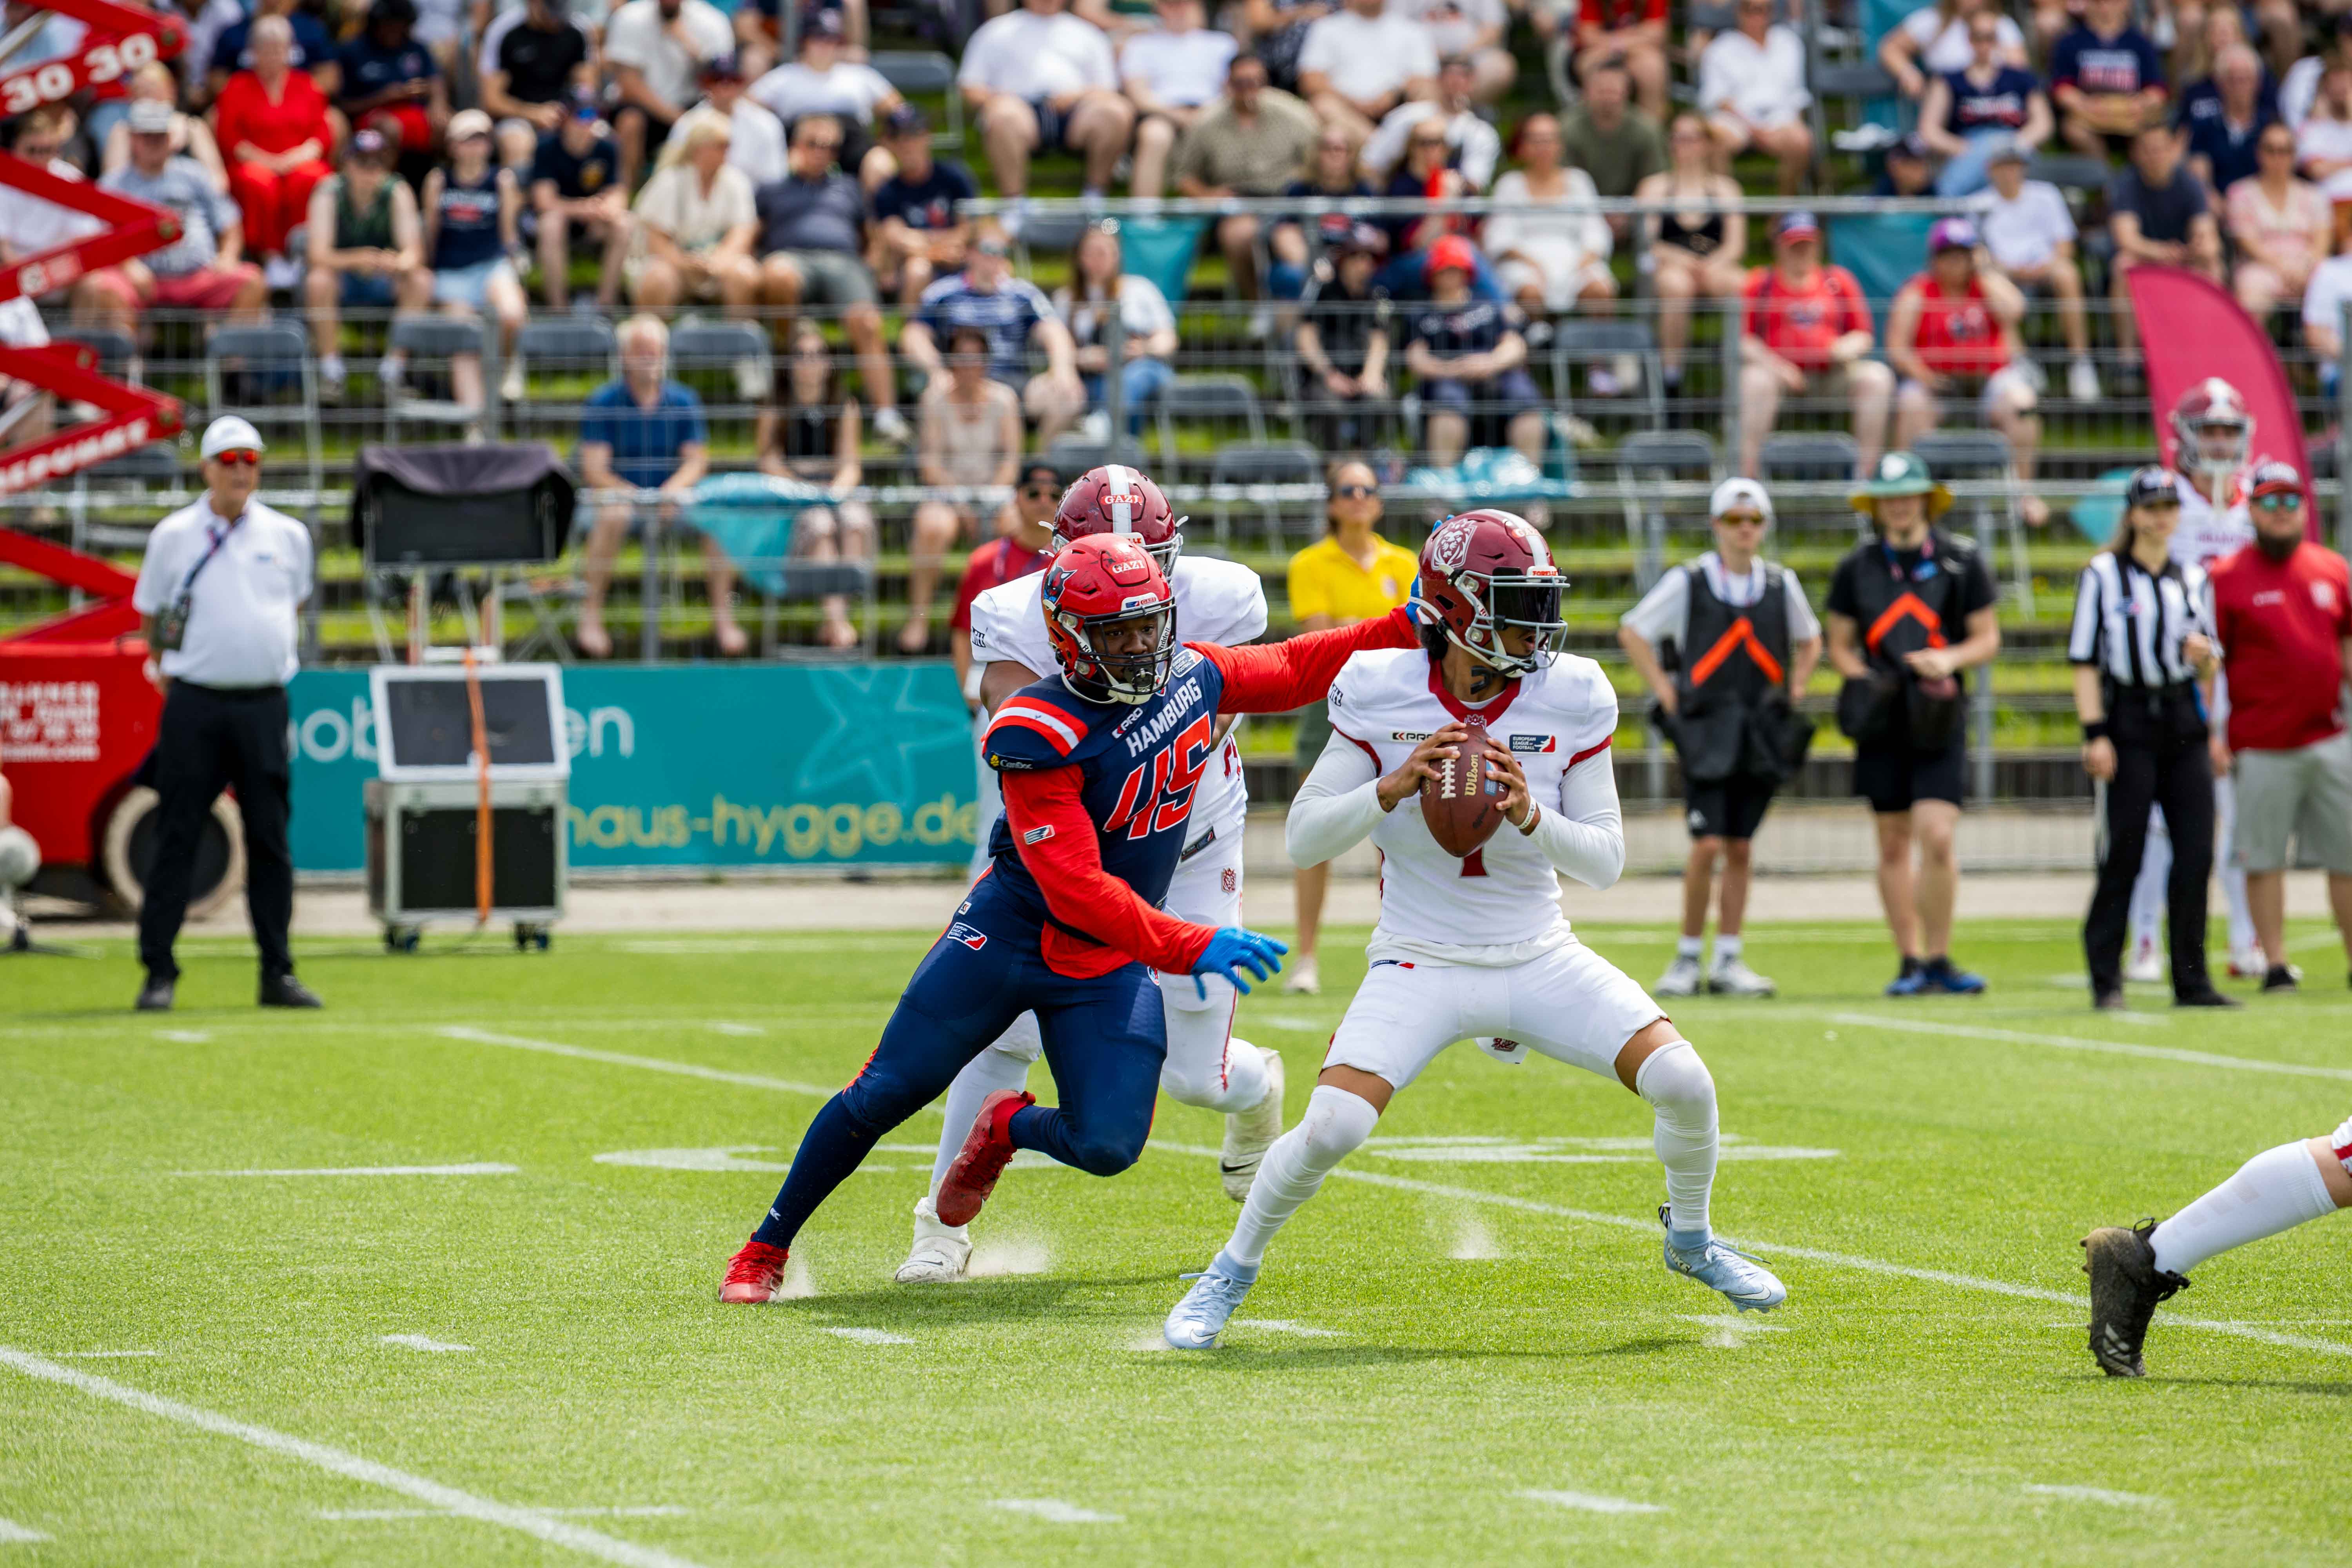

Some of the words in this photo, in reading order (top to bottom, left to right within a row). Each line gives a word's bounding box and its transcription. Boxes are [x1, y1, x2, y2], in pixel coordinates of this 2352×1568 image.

[83, 32, 157, 84] 30
[1, 63, 74, 113] 30
[1104, 495, 1139, 505] GAZI
[1112, 559, 1145, 573] GAZI
[1158, 627, 1171, 652] Riddell
[1125, 676, 1202, 758] HAMBURG
[1102, 710, 1211, 840] 45
[1465, 754, 1479, 796] Wilson
